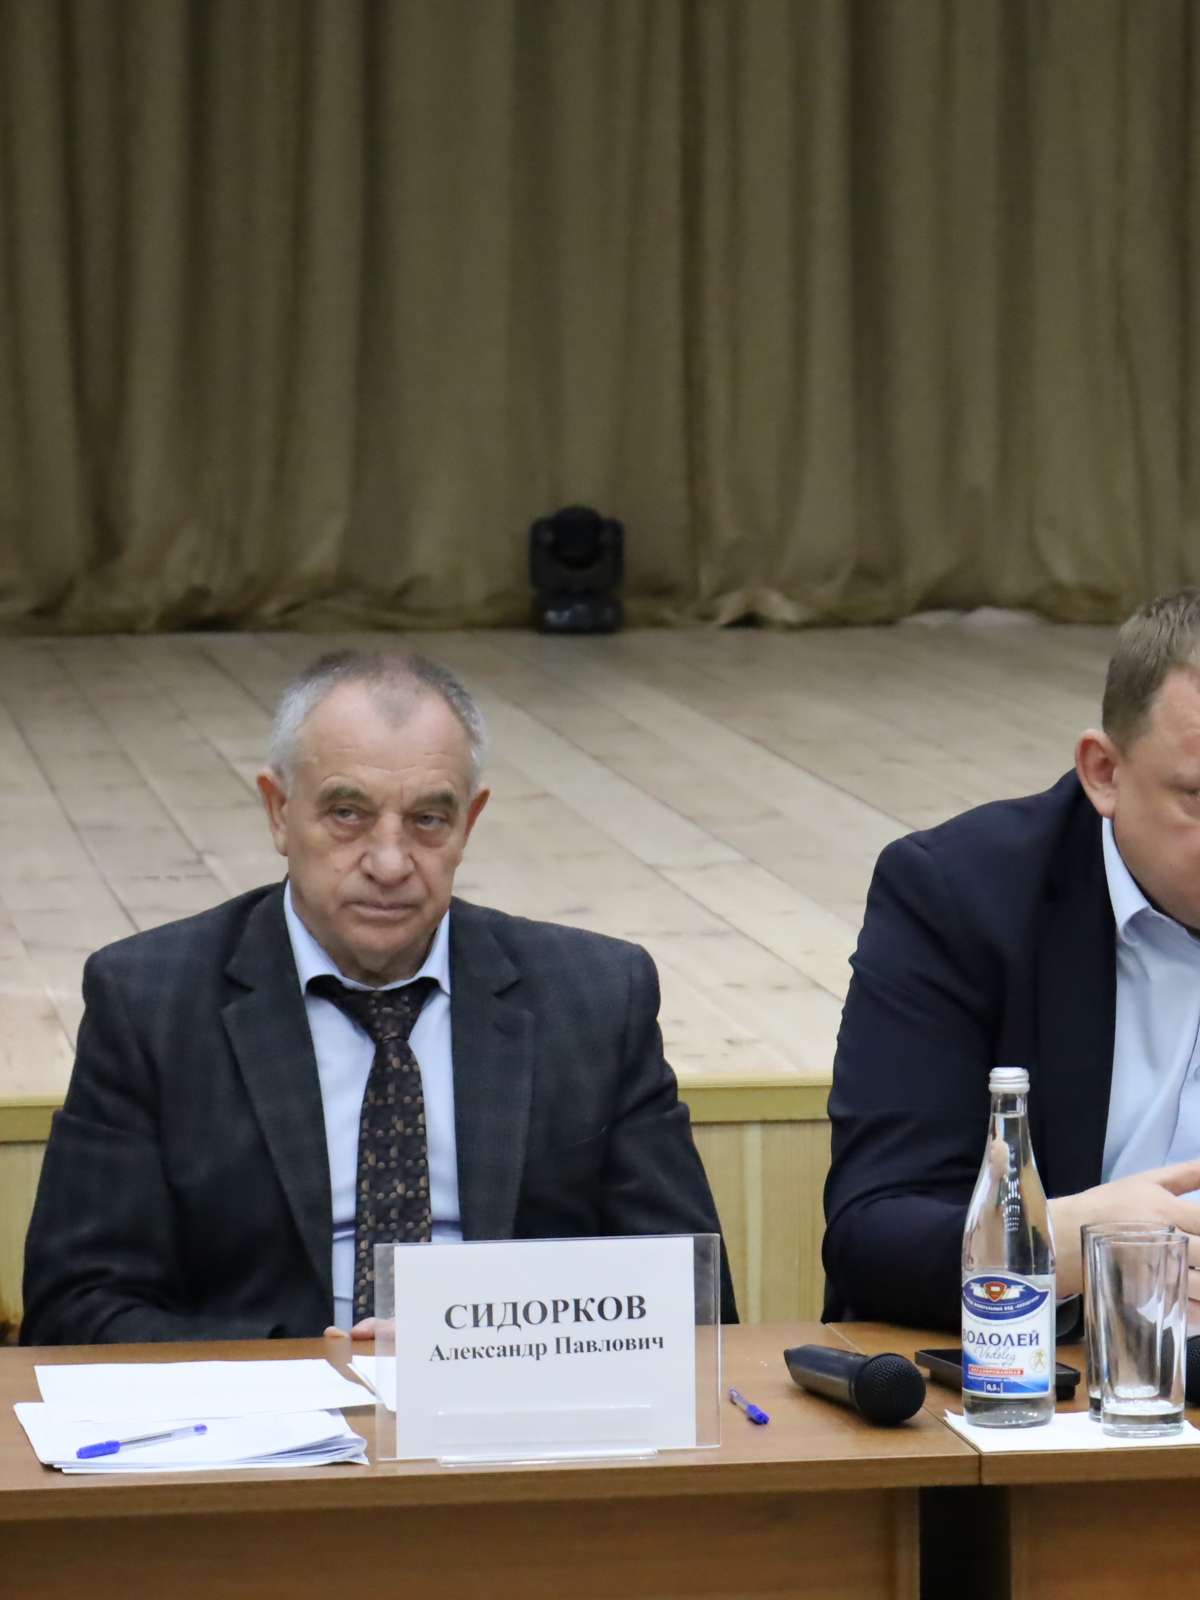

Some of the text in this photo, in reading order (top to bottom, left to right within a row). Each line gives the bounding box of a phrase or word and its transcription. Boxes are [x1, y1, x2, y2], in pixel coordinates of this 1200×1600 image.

[444, 1295, 647, 1332] СИДОРКОВ
[429, 1336, 664, 1362] Александр Павлович
[963, 1328, 1040, 1347] ВОДОЛЕЙ
[974, 1345, 1016, 1369] Vodoley
